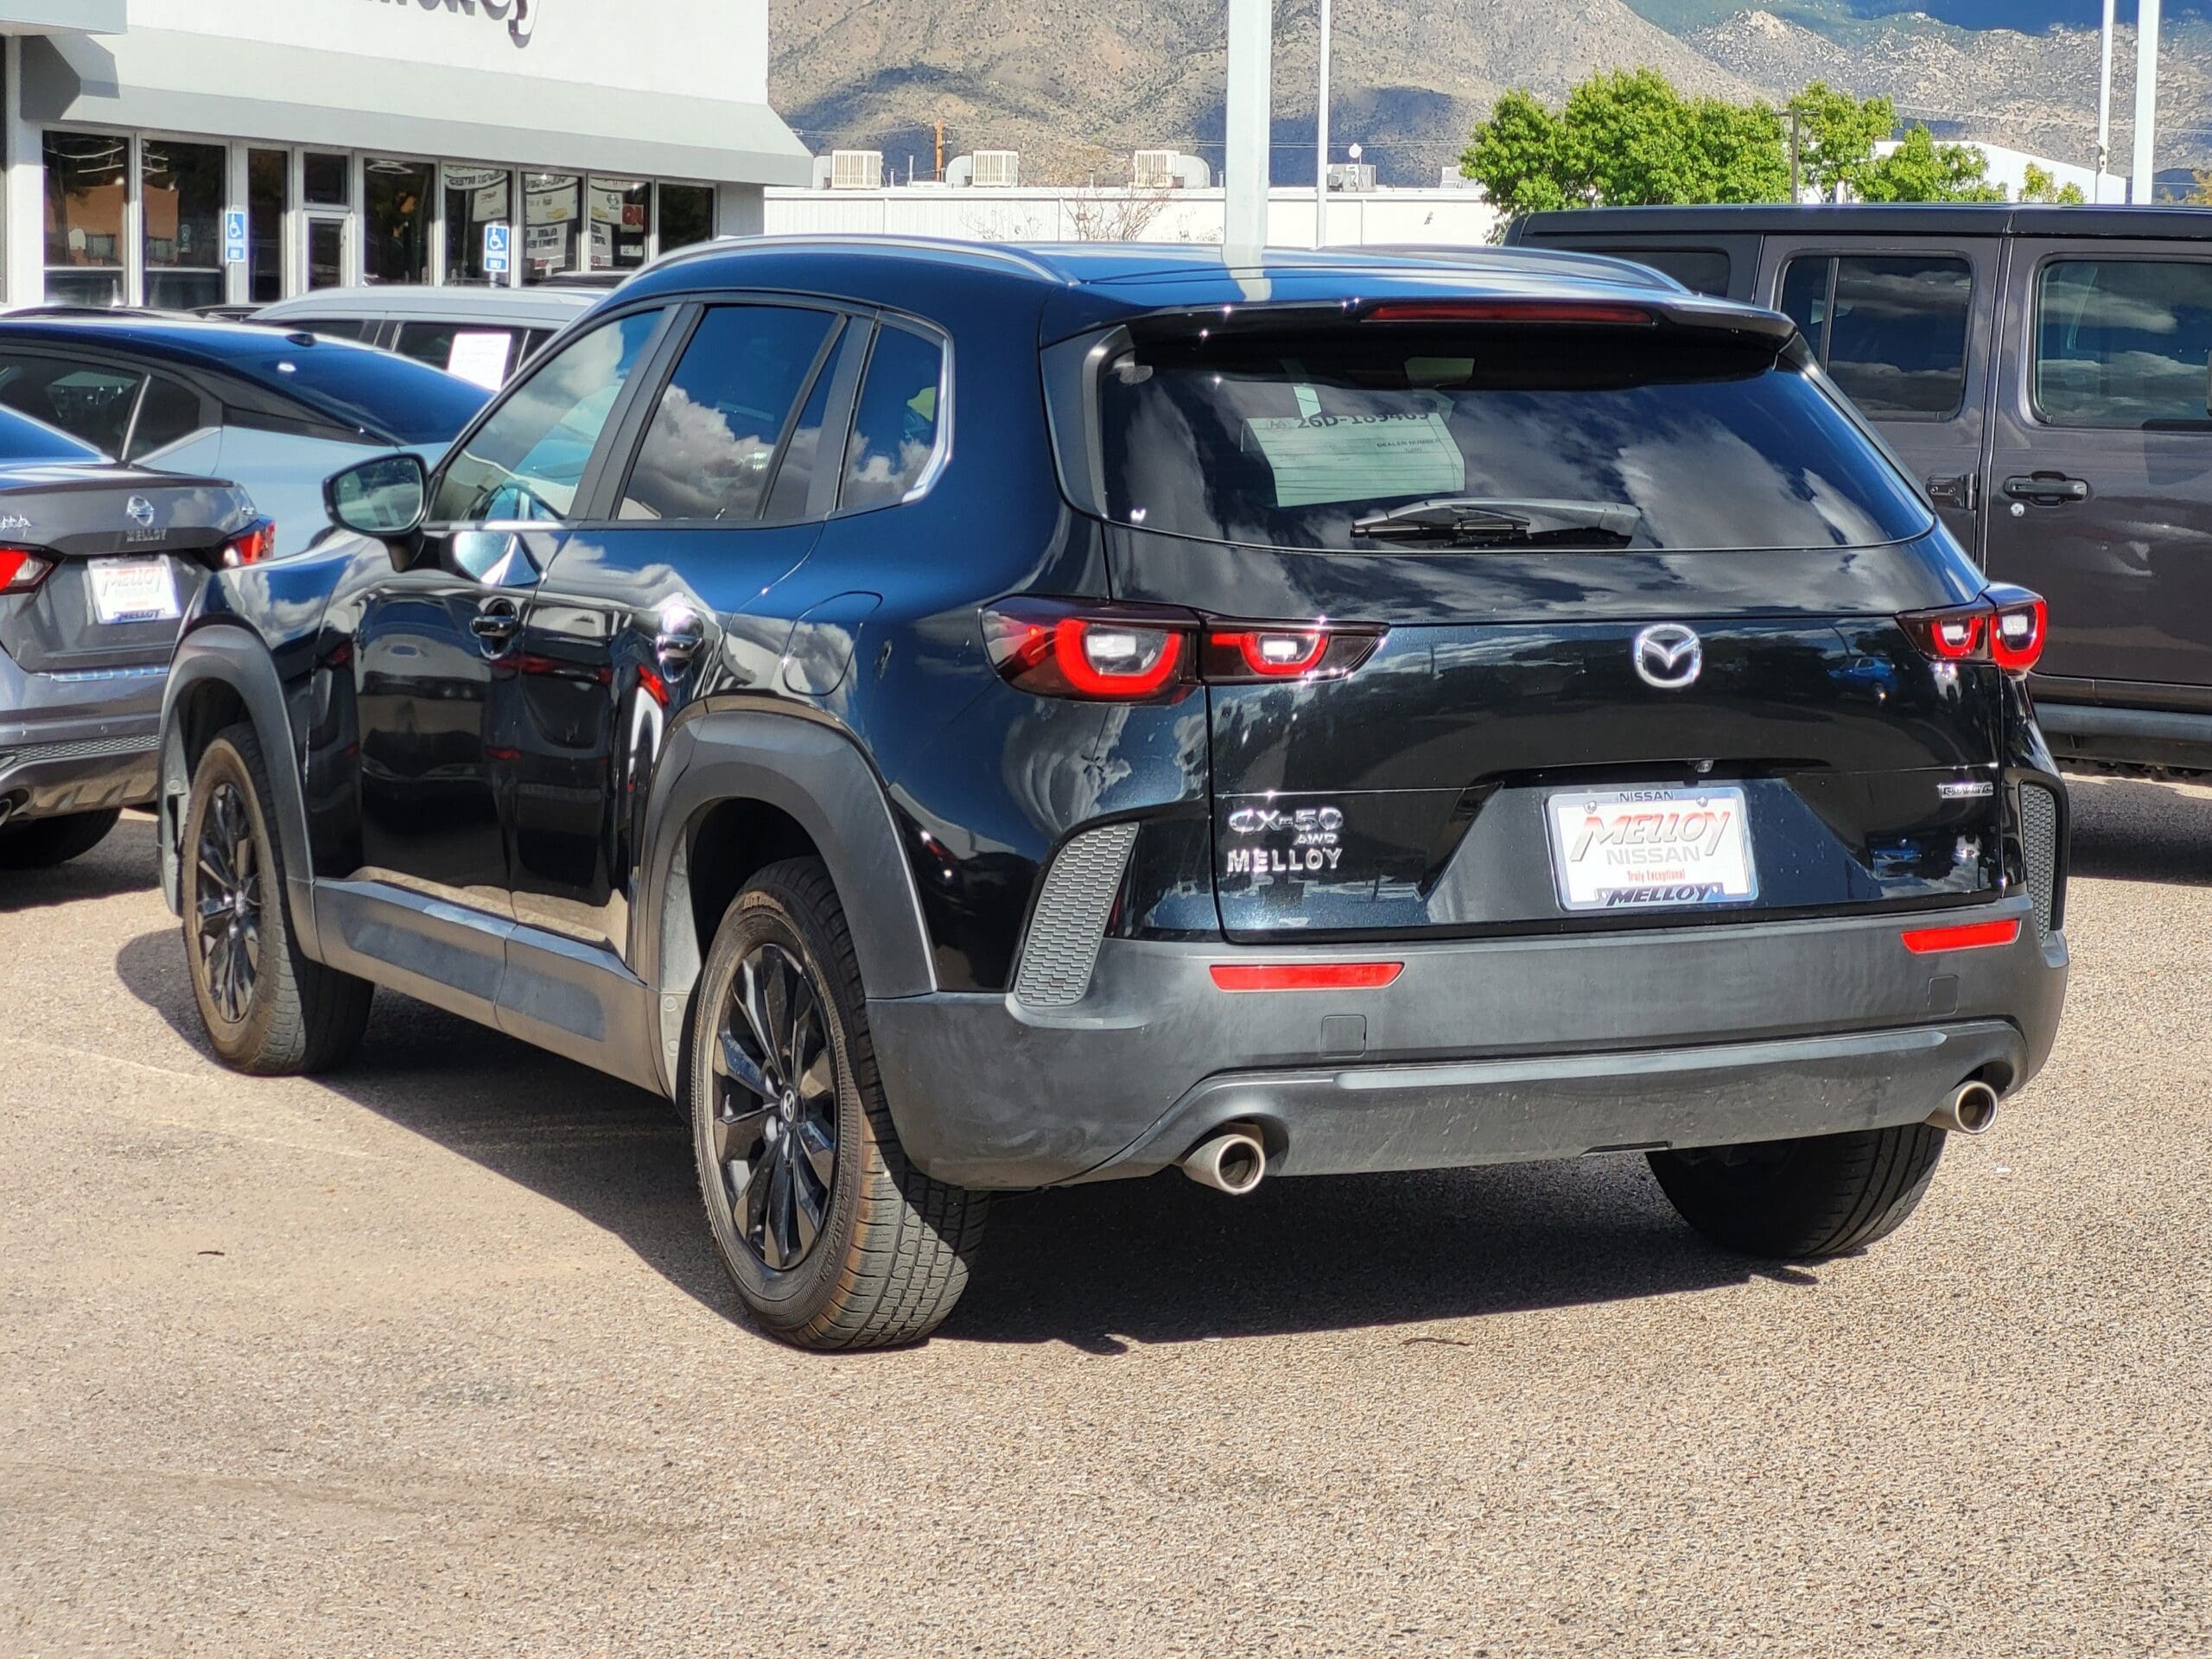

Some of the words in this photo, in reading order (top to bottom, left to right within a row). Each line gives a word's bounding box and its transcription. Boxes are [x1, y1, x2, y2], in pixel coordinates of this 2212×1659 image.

[126, 528, 168, 543] MELLOY
[1618, 791, 1675, 802] NISSAN
[1228, 806, 1344, 833] CX-50
[1570, 810, 1732, 863] MELLOY
[1226, 847, 1343, 873] MELLOY
[1605, 845, 1701, 867] NISSAN
[1626, 868, 1646, 884] Truly
[1646, 868, 1686, 882] Exceptional
[1605, 883, 1713, 907] MELLOY
